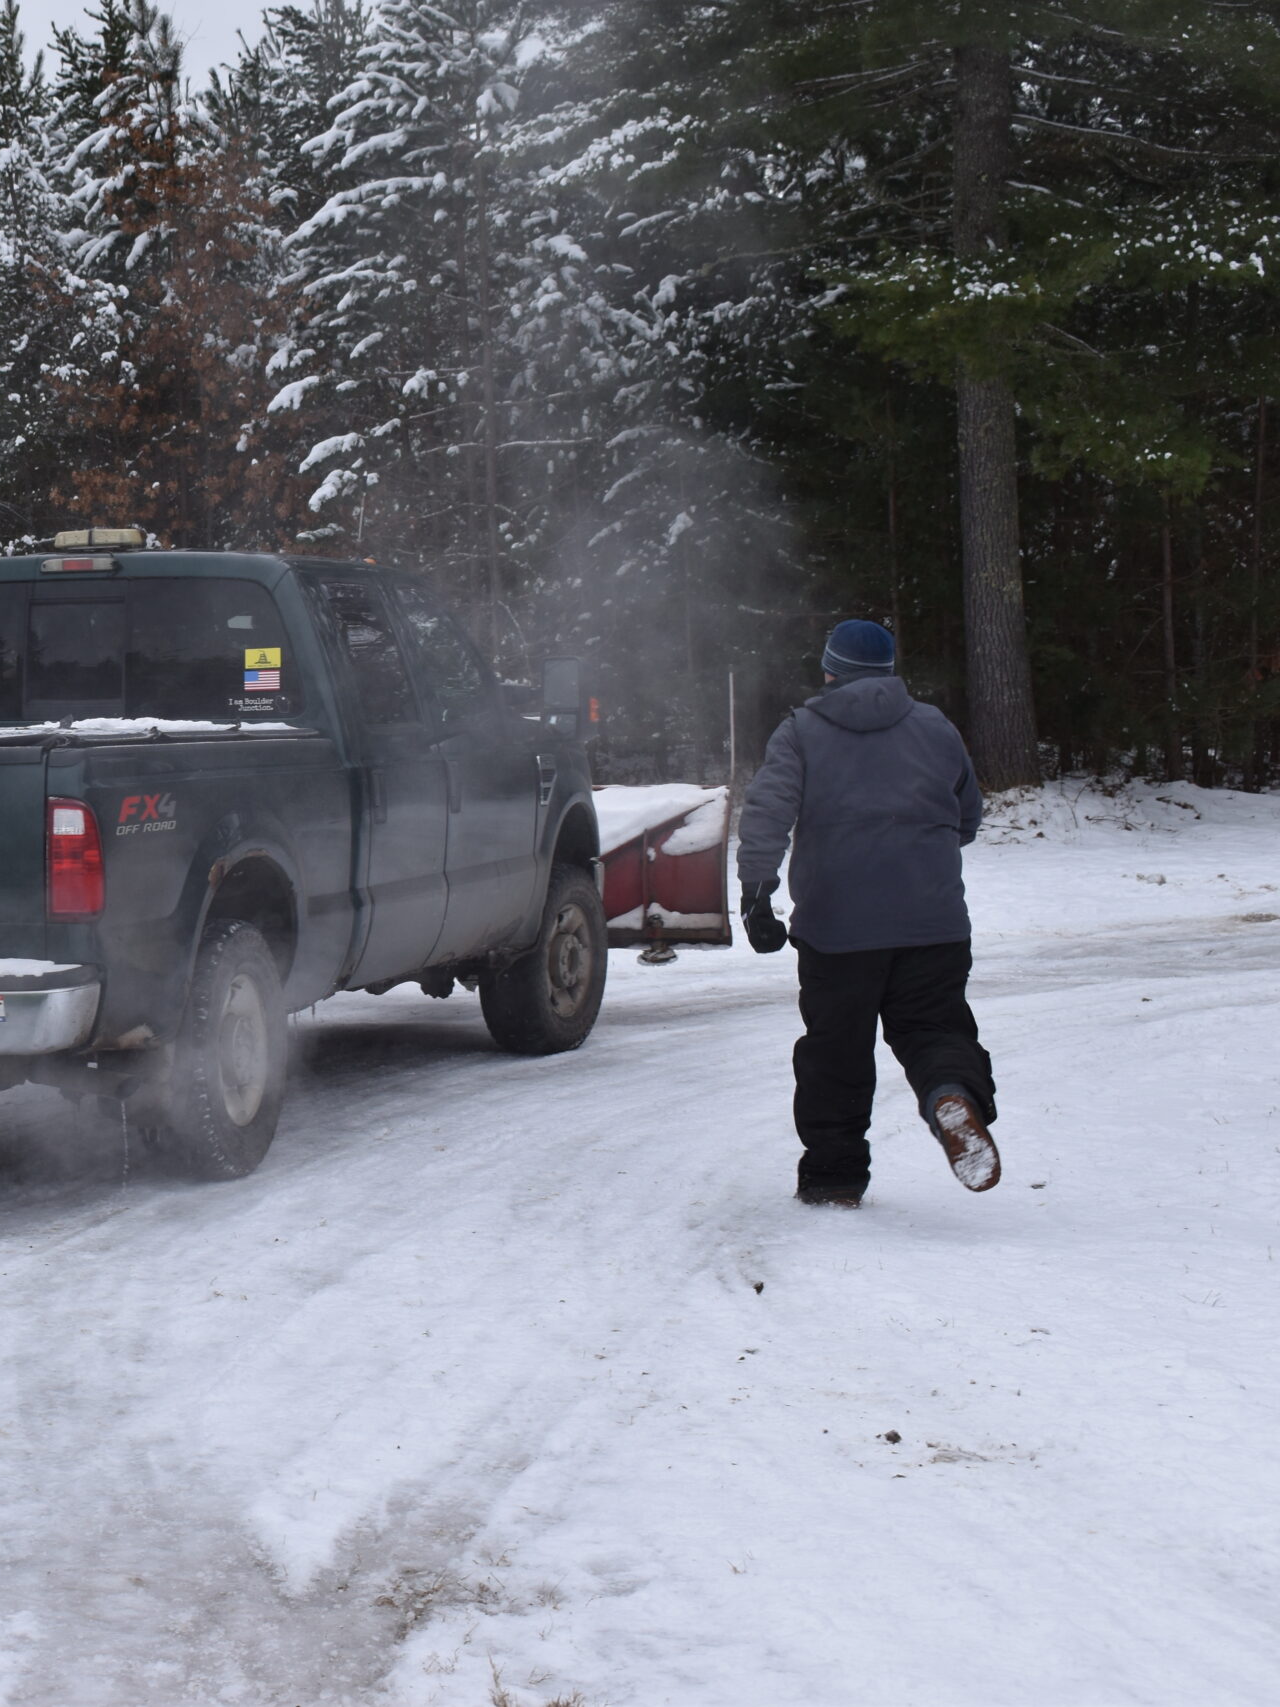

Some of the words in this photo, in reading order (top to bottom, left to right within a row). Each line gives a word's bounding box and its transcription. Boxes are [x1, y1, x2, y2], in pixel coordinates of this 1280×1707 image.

[118, 792, 177, 824] FX4
[115, 823, 140, 836] OFF
[142, 820, 177, 833] ROAD
